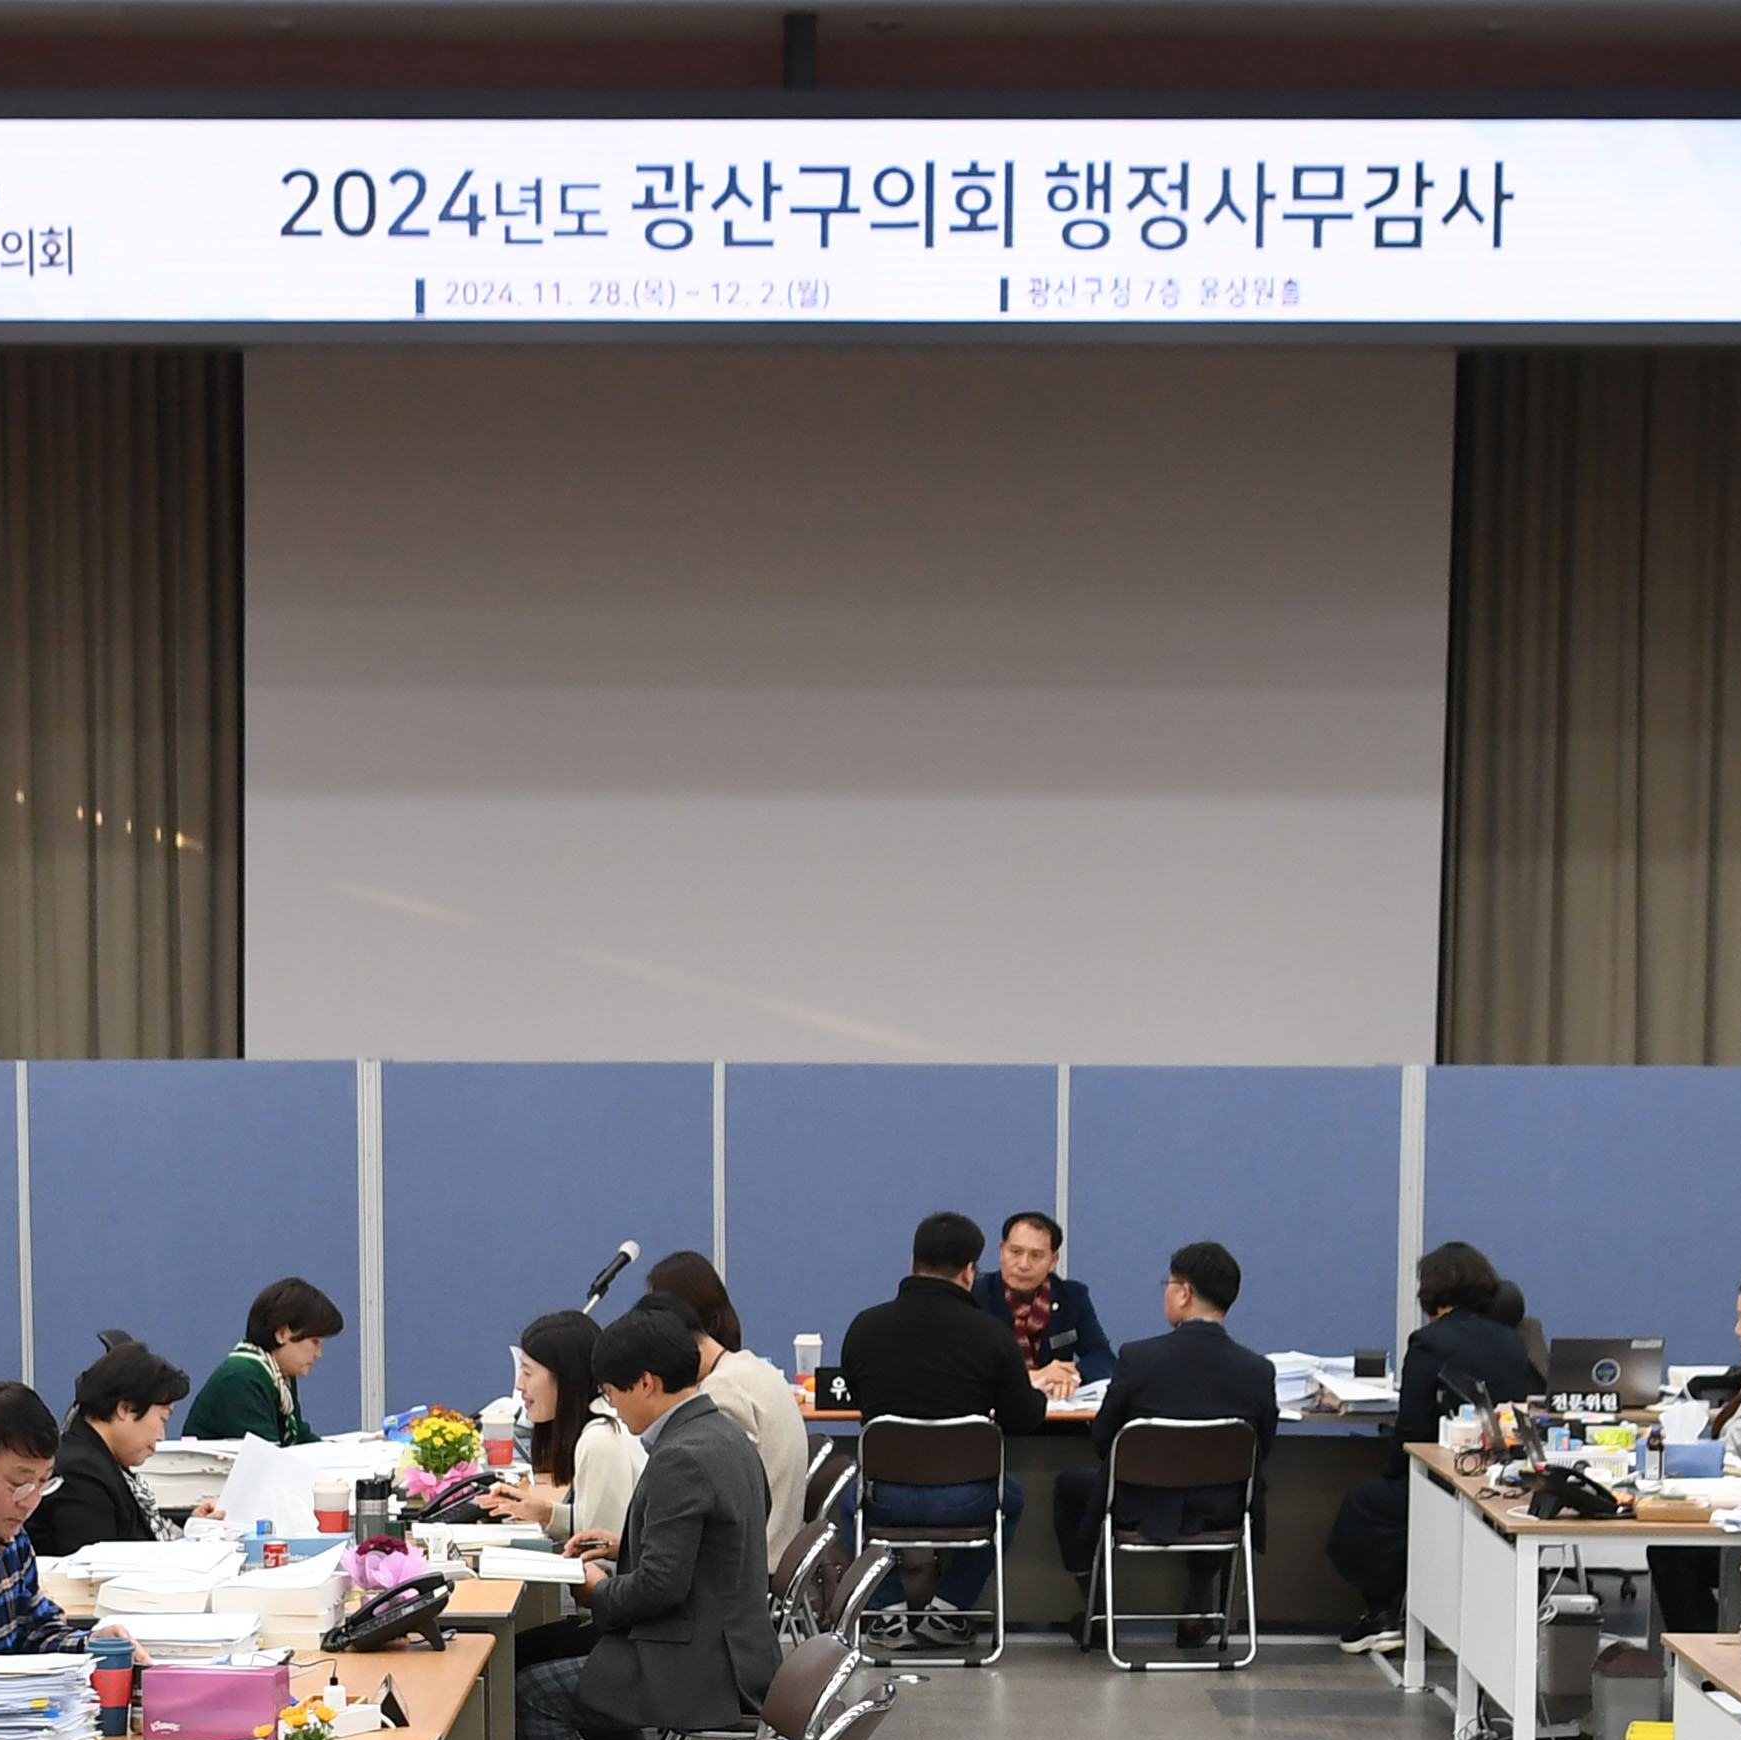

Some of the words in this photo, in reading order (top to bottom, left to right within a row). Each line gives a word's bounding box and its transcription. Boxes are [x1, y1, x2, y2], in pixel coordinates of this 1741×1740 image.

[280, 168, 608, 245] 2024년도
[630, 159, 1015, 251] 광산구의회
[1044, 159, 1515, 251] 행정사무감사
